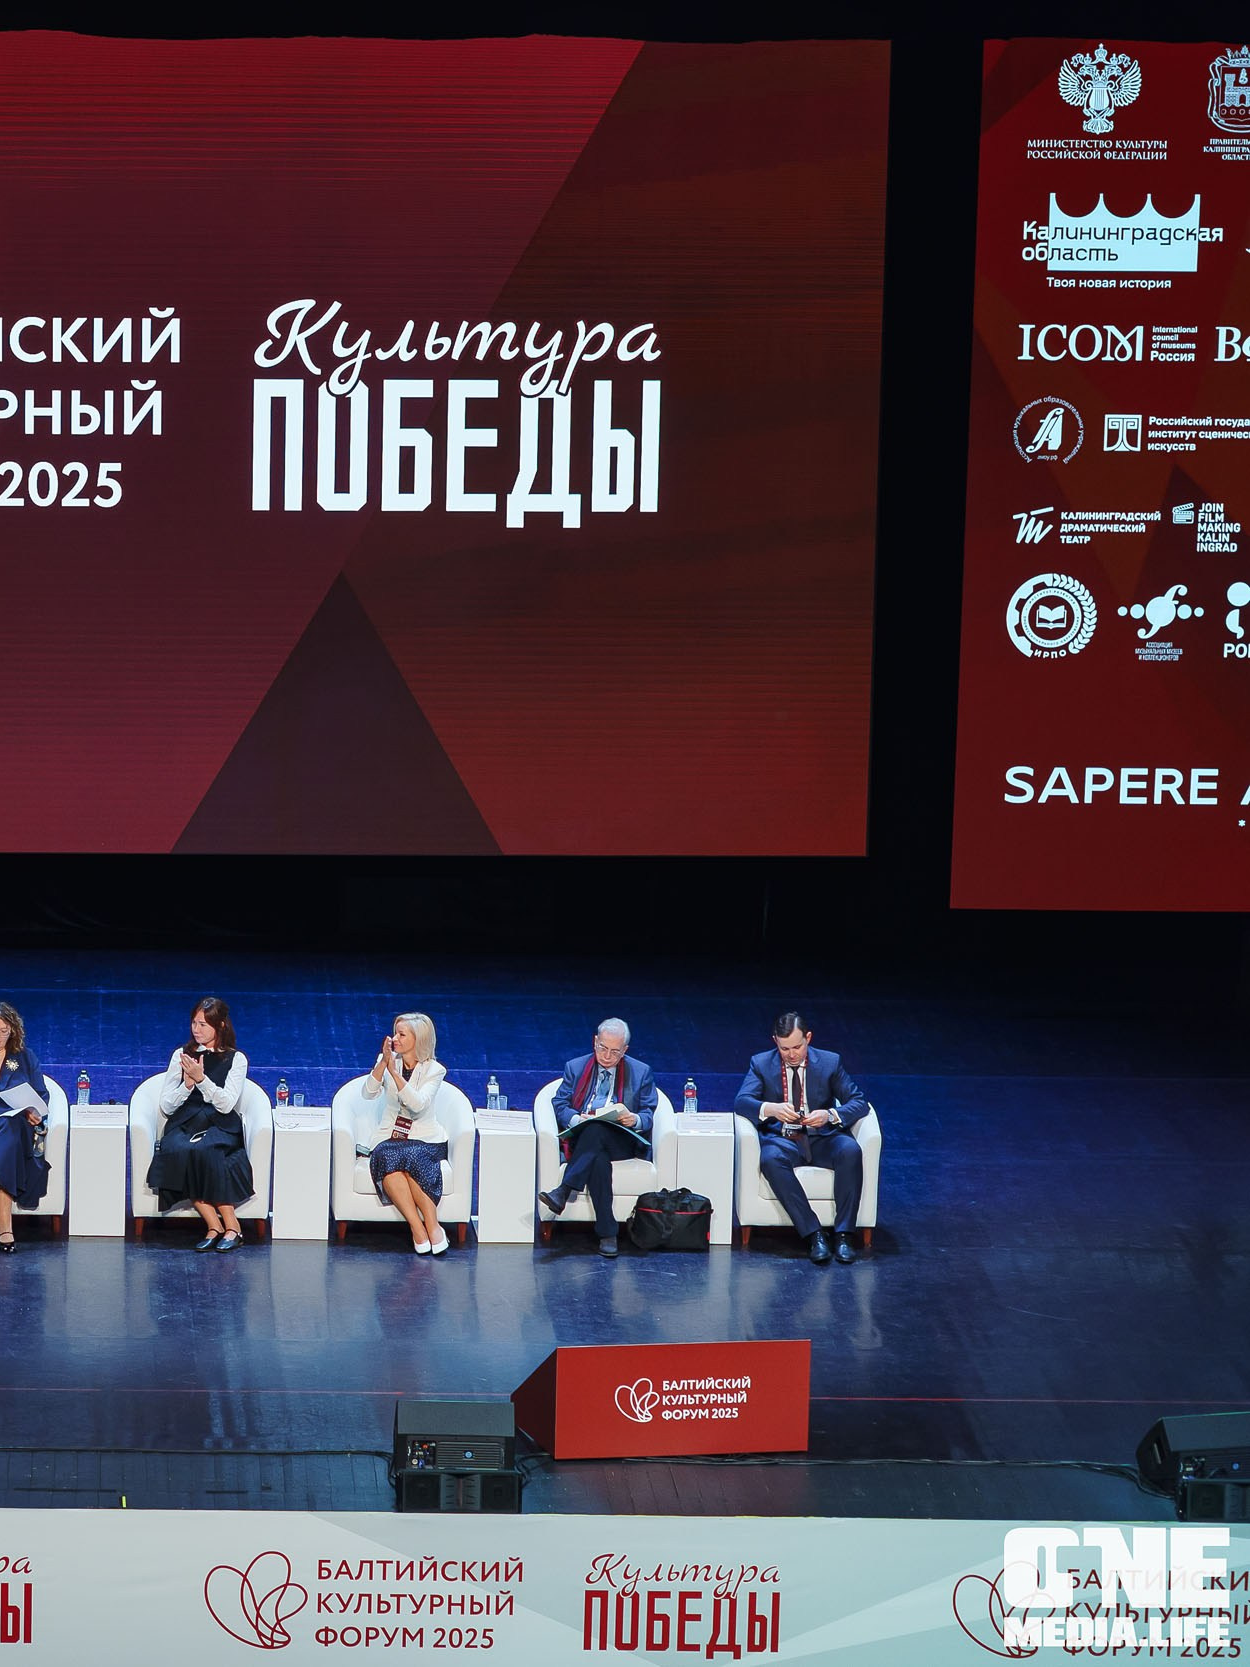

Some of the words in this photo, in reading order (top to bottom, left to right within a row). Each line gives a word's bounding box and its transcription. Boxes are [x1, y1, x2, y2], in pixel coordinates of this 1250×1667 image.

[1027, 139, 1113, 149] МИНИСТЕРСТВО
[1116, 140, 1168, 150] КУЛЬТУРЫ
[1027, 149, 1101, 160] РОССИЙСКОЙ
[1104, 150, 1167, 160] ФЕДЕРАЦИИ
[1022, 220, 1224, 246] Калининградская
[1021, 243, 1119, 262] область
[1046, 276, 1076, 288] Твоя
[1079, 279, 1116, 288] новая
[1119, 279, 1172, 290] история
[253, 298, 662, 397] Культура
[1017, 323, 1145, 362] ICOM
[1150, 350, 1196, 362] Россия
[1149, 416, 1213, 426] Российский
[1147, 430, 1197, 441] институт
[251, 379, 662, 529] ПОБЕДЫ
[1147, 442, 1196, 453] искусств
[1198, 503, 1224, 513] JOIN
[1060, 510, 1161, 521] КАЛИНИНГРАДСКИЙ
[1198, 513, 1225, 522] FILM
[1060, 522, 1146, 533] ДРАМАТИЧЕСКИЙ
[1197, 523, 1241, 533] MAKING
[1060, 535, 1091, 545] ТЕАТР
[1197, 533, 1230, 543] KALIN
[1196, 543, 1238, 553] INGRAD
[1034, 648, 1067, 659] ИРПО
[1223, 643, 1250, 658] РО
[1004, 765, 1219, 805] SAPERE
[662, 1376, 751, 1391] БАЛТИЙСКИЙ
[662, 1391, 747, 1406] КУЛЬТУРНЫЙ
[661, 1409, 709, 1421] ФОРУМ
[711, 1407, 739, 1419] 2025
[316, 1556, 524, 1584] БАЛТИЙСКИЙ
[585, 1553, 781, 1599] Культура
[316, 1591, 515, 1617] КУЛЬТУРНЫЙ
[583, 1590, 781, 1660] ПОБЕДЫ
[315, 1625, 425, 1649] ФОРУМ
[432, 1627, 495, 1650] 2025
